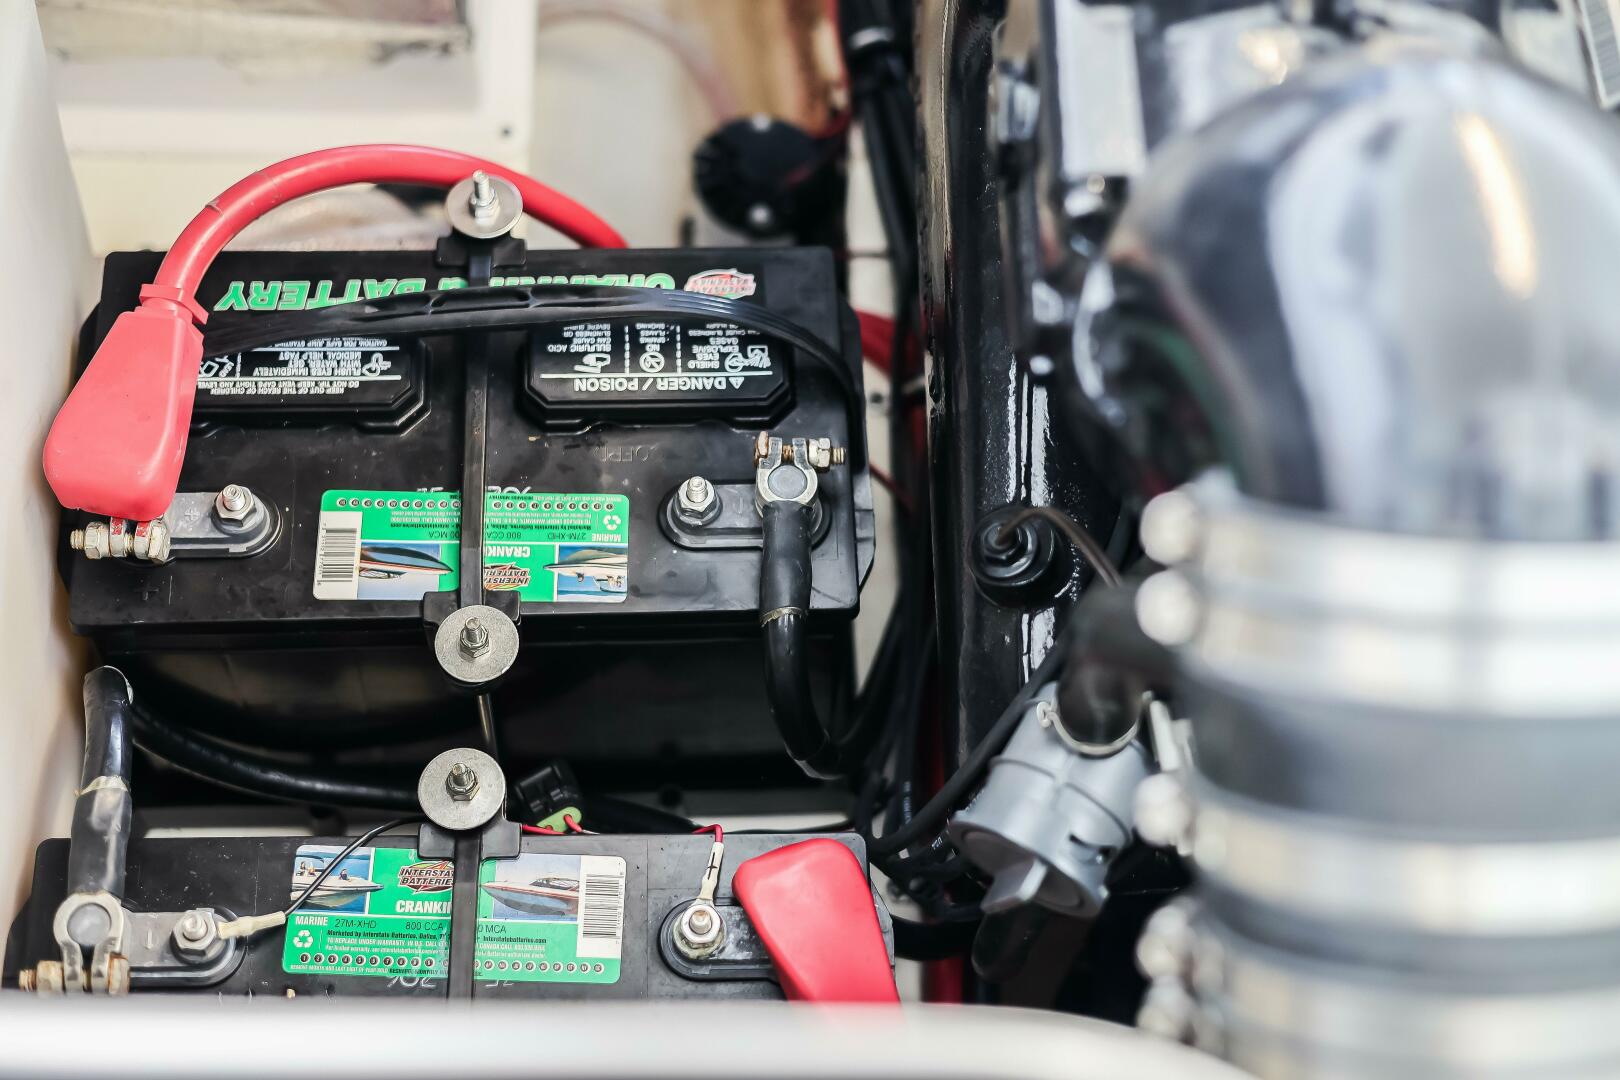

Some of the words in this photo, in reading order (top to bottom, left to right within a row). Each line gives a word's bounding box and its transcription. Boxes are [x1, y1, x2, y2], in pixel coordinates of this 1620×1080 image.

[708, 337, 738, 345] GASES
[546, 344, 568, 352] ACID
[570, 344, 612, 352] SULFURIC
[644, 344, 660, 352] NO
[692, 344, 739, 353] EXPLOSIVE
[278, 352, 299, 360] FAST
[301, 351, 323, 360] HELP
[326, 351, 361, 360] MEDICAL
[696, 352, 720, 360] EYES
[287, 359, 305, 368] GET
[340, 359, 361, 368] WITH
[687, 360, 720, 369] SHIELD
[253, 367, 308, 376] IMMEDIATELY
[310, 368, 332, 376] EYES
[334, 367, 361, 376] FLUSH
[573, 378, 639, 392] POISON
[655, 376, 727, 390] DANGER
[428, 530, 448, 538] MCA
[506, 531, 522, 540] 800
[592, 534, 622, 542] MARINE
[296, 916, 328, 926] MARINE
[334, 918, 376, 928] 27M-XHD
[406, 921, 421, 930] 800
[424, 922, 444, 931] CCA
[485, 925, 506, 934] MCA
